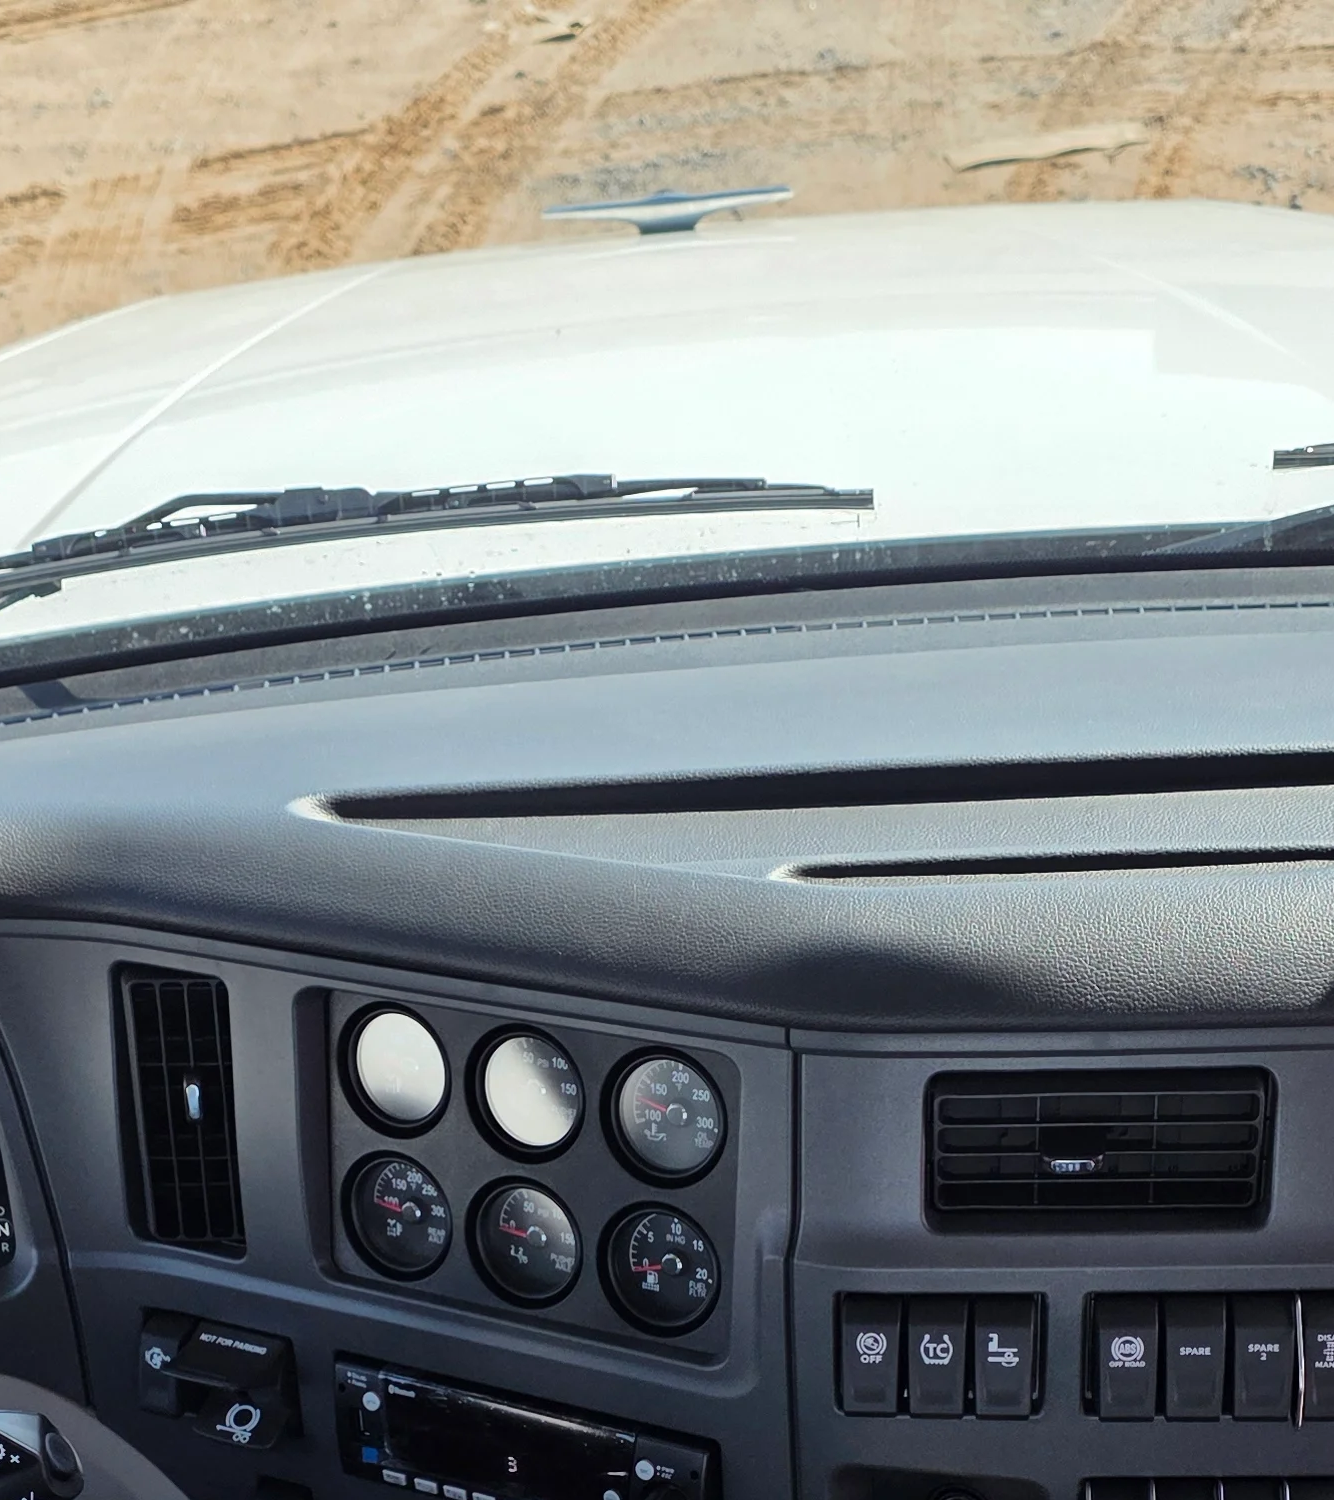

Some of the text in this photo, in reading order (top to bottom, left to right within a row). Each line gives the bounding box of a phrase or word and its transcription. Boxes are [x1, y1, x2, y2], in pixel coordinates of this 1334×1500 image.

[672, 1071, 689, 1084] 200
[560, 1083, 577, 1096] 150
[650, 1083, 667, 1096] 150
[692, 1089, 710, 1102] 250
[645, 1109, 661, 1122] 100
[696, 1116, 713, 1129] 300
[697, 1131, 708, 1140] OIL
[695, 1139, 714, 1149] TEMP
[407, 1171, 423, 1184] 200
[391, 1178, 407, 1191] 150
[523, 1201, 534, 1213] 50
[428, 1227, 446, 1236] REAR
[671, 1223, 681, 1235] 10
[648, 1231, 654, 1243] 5
[1, 1242, 9, 1252] R
[693, 1239, 704, 1252] 15
[696, 1268, 708, 1280] 20
[689, 1280, 706, 1290] FUEL
[199, 1333, 267, 1355] NOT FOR PARKING
[1119, 1343, 1137, 1354] ABS
[1248, 1343, 1280, 1353] SPARE
[926, 1343, 948, 1358] TC
[1179, 1346, 1211, 1356] SPARE
[860, 1355, 883, 1364] OFF
[1260, 1353, 1267, 1361] 2
